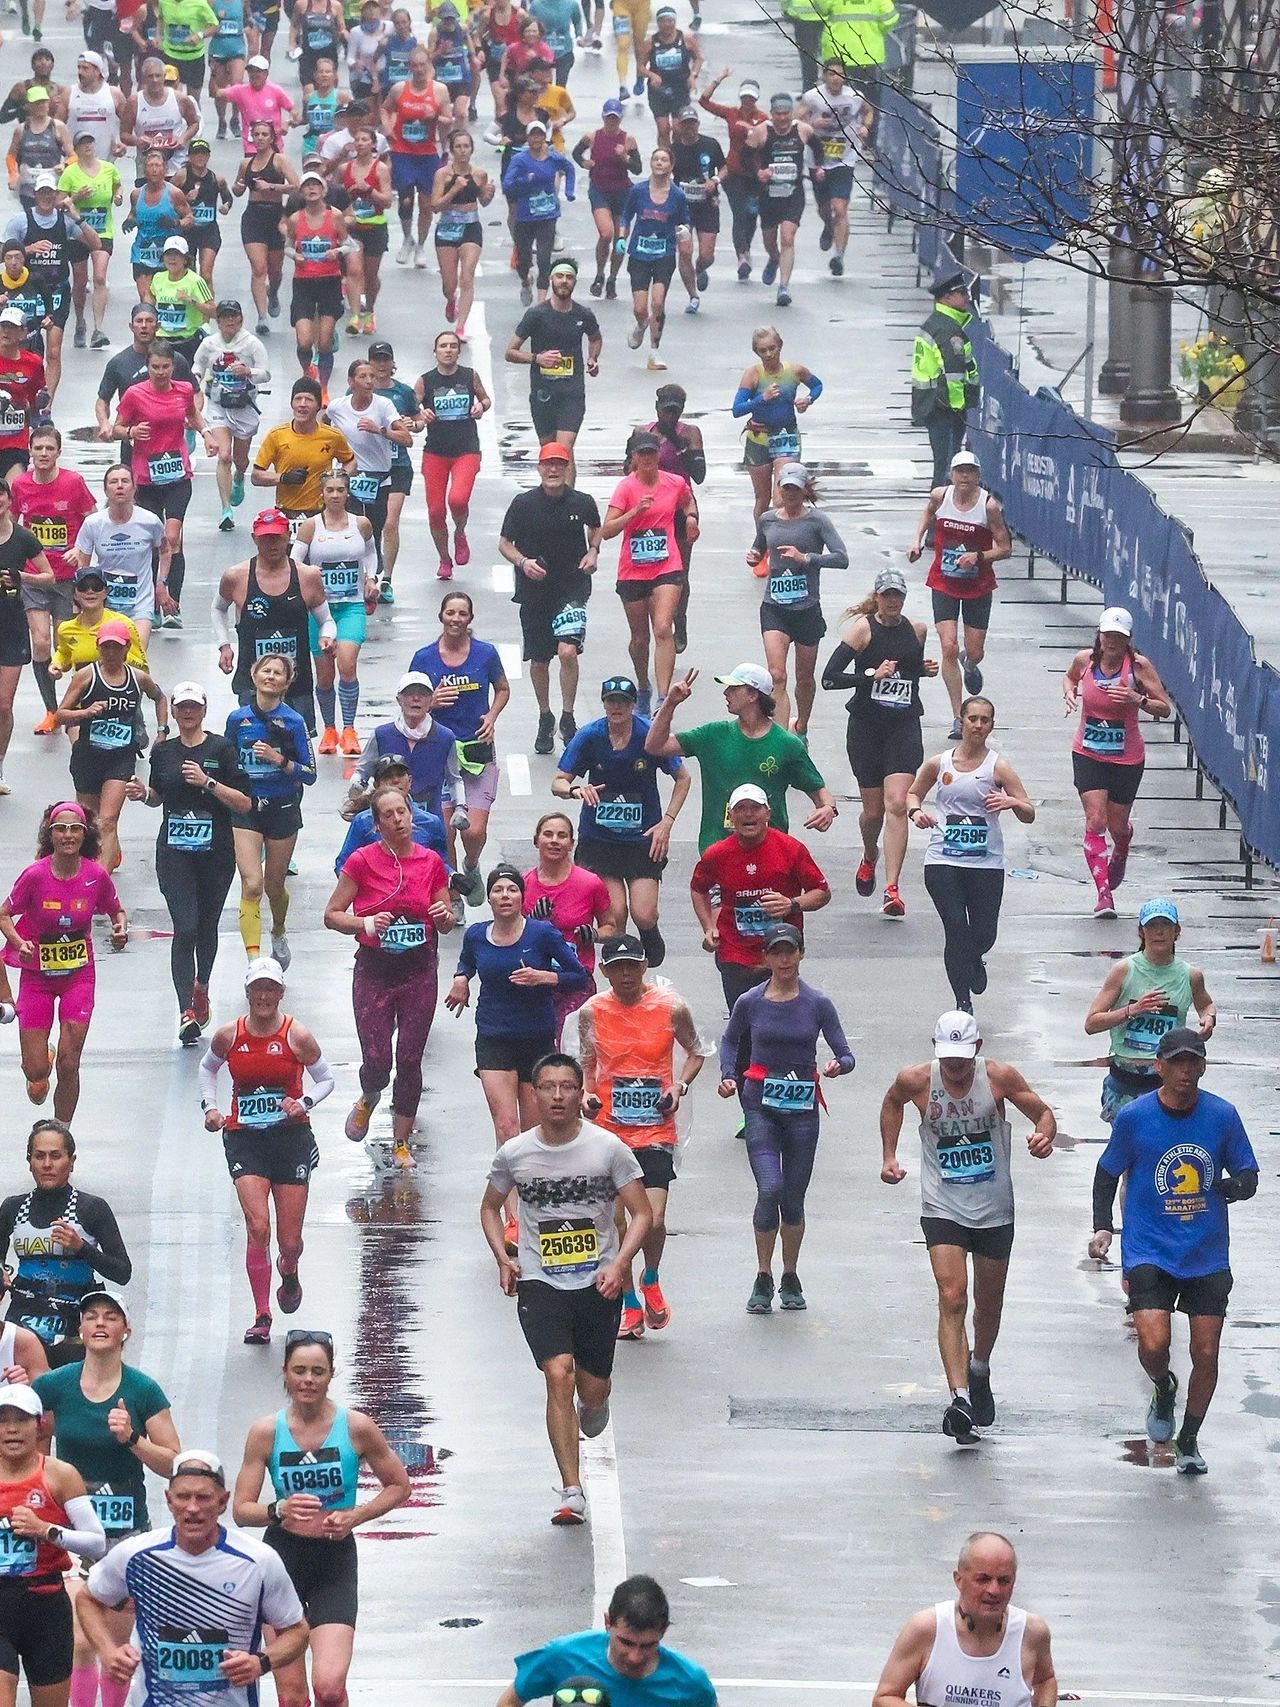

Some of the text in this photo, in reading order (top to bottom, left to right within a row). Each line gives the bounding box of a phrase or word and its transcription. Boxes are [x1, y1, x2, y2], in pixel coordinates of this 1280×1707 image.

[944, 521, 975, 532] CANADA
[443, 675, 469, 686] Kim
[875, 681, 910, 696] 12471
[598, 807, 640, 820] 22260
[169, 824, 211, 837] 22577
[945, 829, 987, 843] 22595
[42, 945, 87, 961] 31352
[764, 1084, 812, 1099] 22427
[940, 1149, 992, 1167] 20063
[1158, 1164, 1166, 1191] BOSTON
[1164, 1147, 1194, 1165] ATHLETIC
[541, 1233, 595, 1256] 25639
[946, 1684, 1001, 1701] QUAKERS
